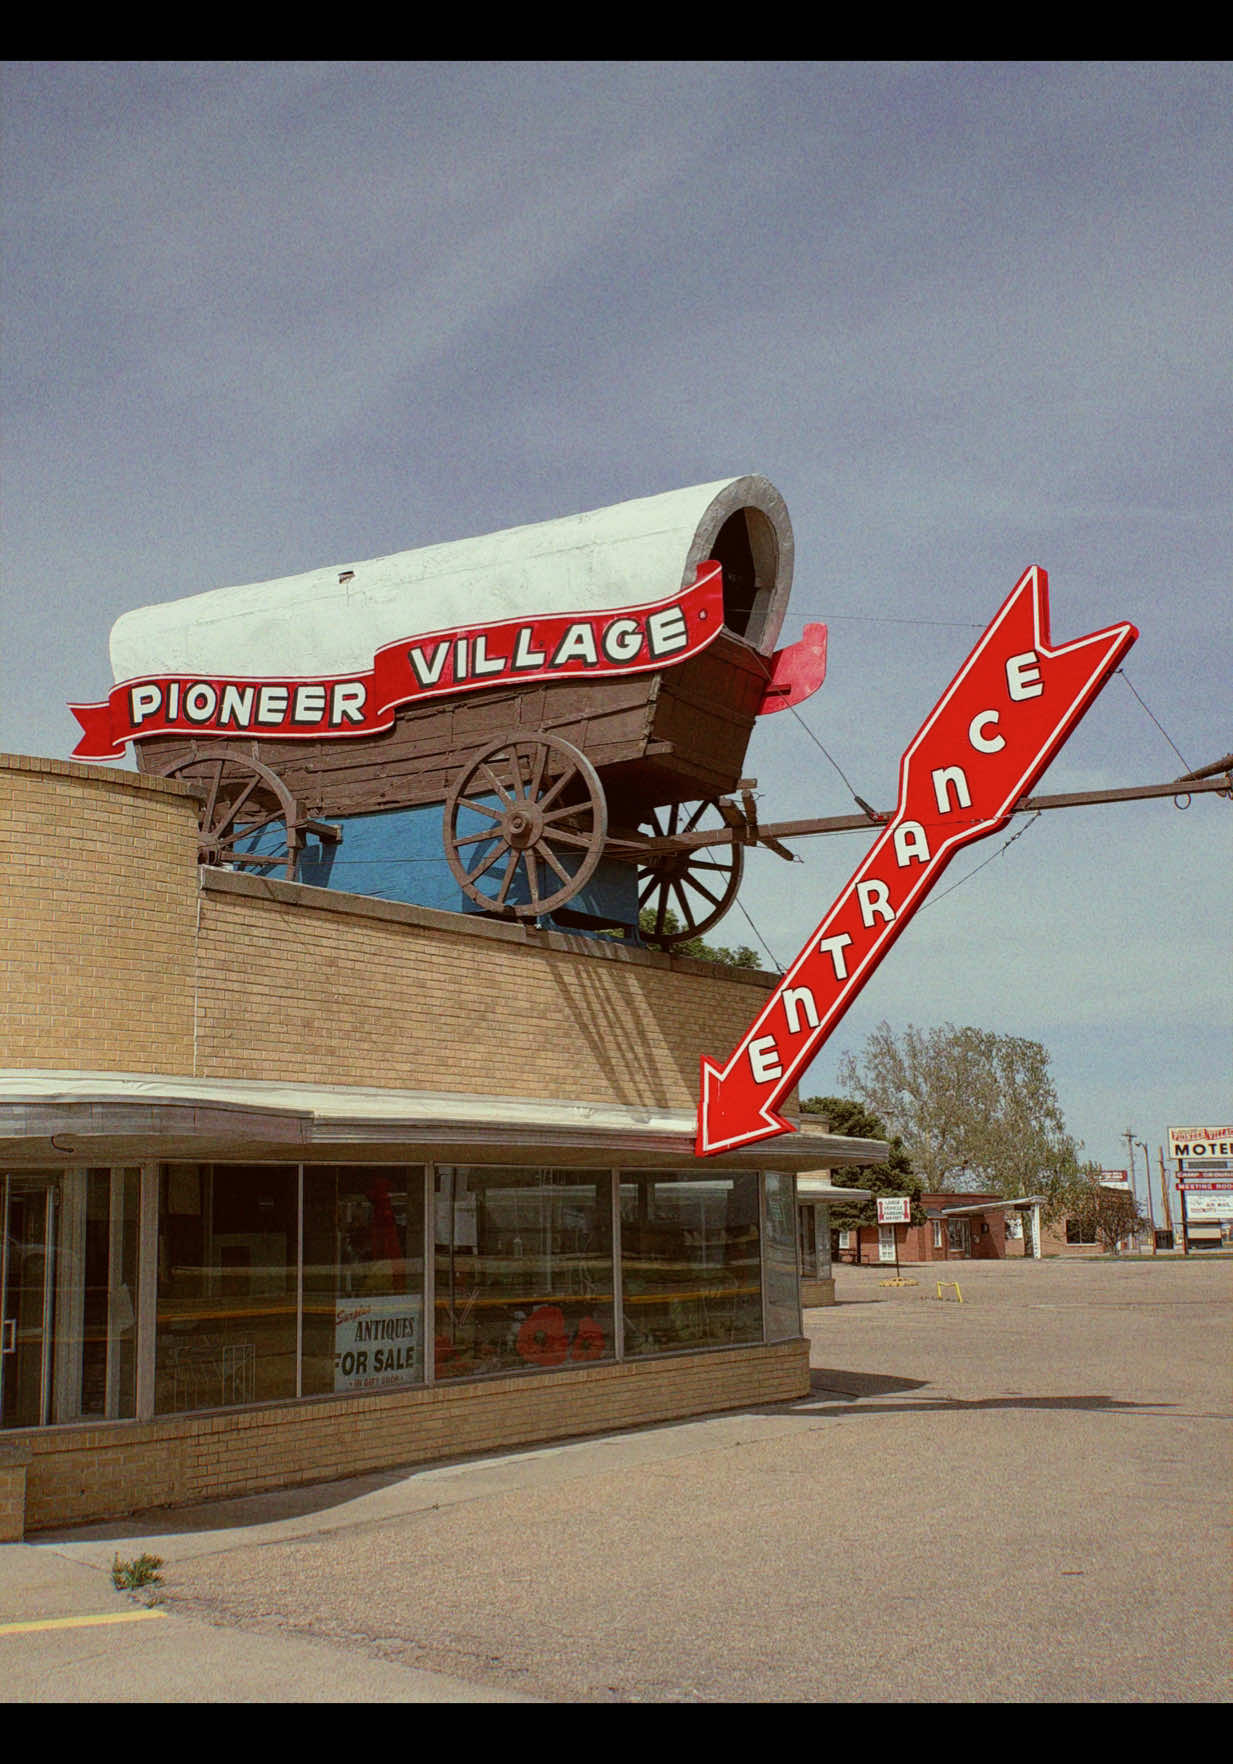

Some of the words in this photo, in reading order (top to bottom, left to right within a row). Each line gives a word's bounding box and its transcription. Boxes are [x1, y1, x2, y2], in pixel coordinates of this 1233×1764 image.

[130, 682, 367, 728] PIONEER
[408, 604, 688, 688] VILLAGE
[355, 1317, 415, 1342] ANTIQUES
[373, 1346, 415, 1372] SALE
